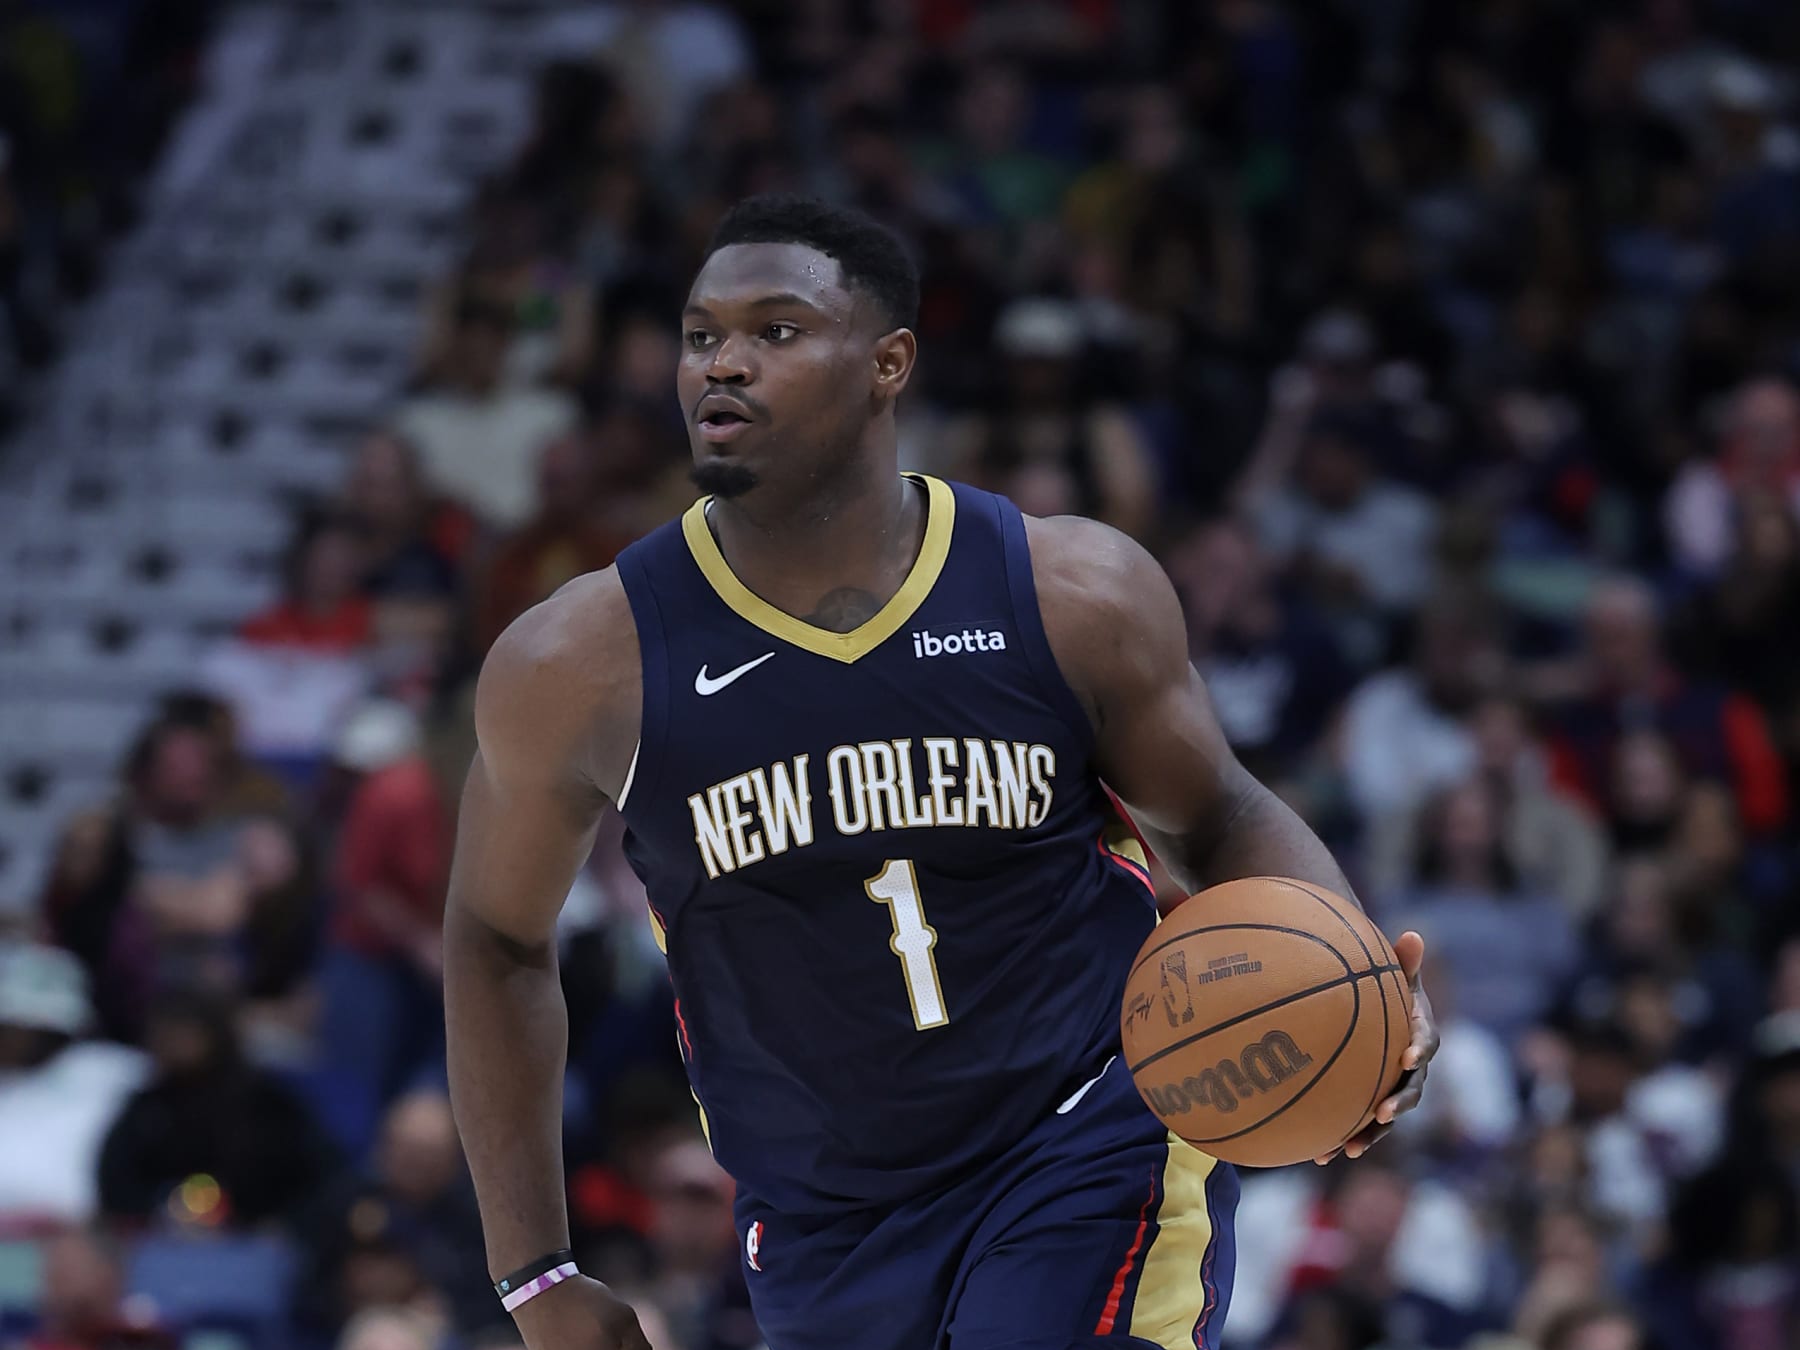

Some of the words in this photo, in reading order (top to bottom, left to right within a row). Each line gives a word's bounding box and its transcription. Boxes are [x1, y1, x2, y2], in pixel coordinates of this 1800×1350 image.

[913, 629, 1006, 658] ibotta
[687, 753, 814, 880] NEW
[827, 737, 1056, 835] ORLEANS
[864, 859, 949, 1031] 1
[1143, 1029, 1314, 1118] Wilson
